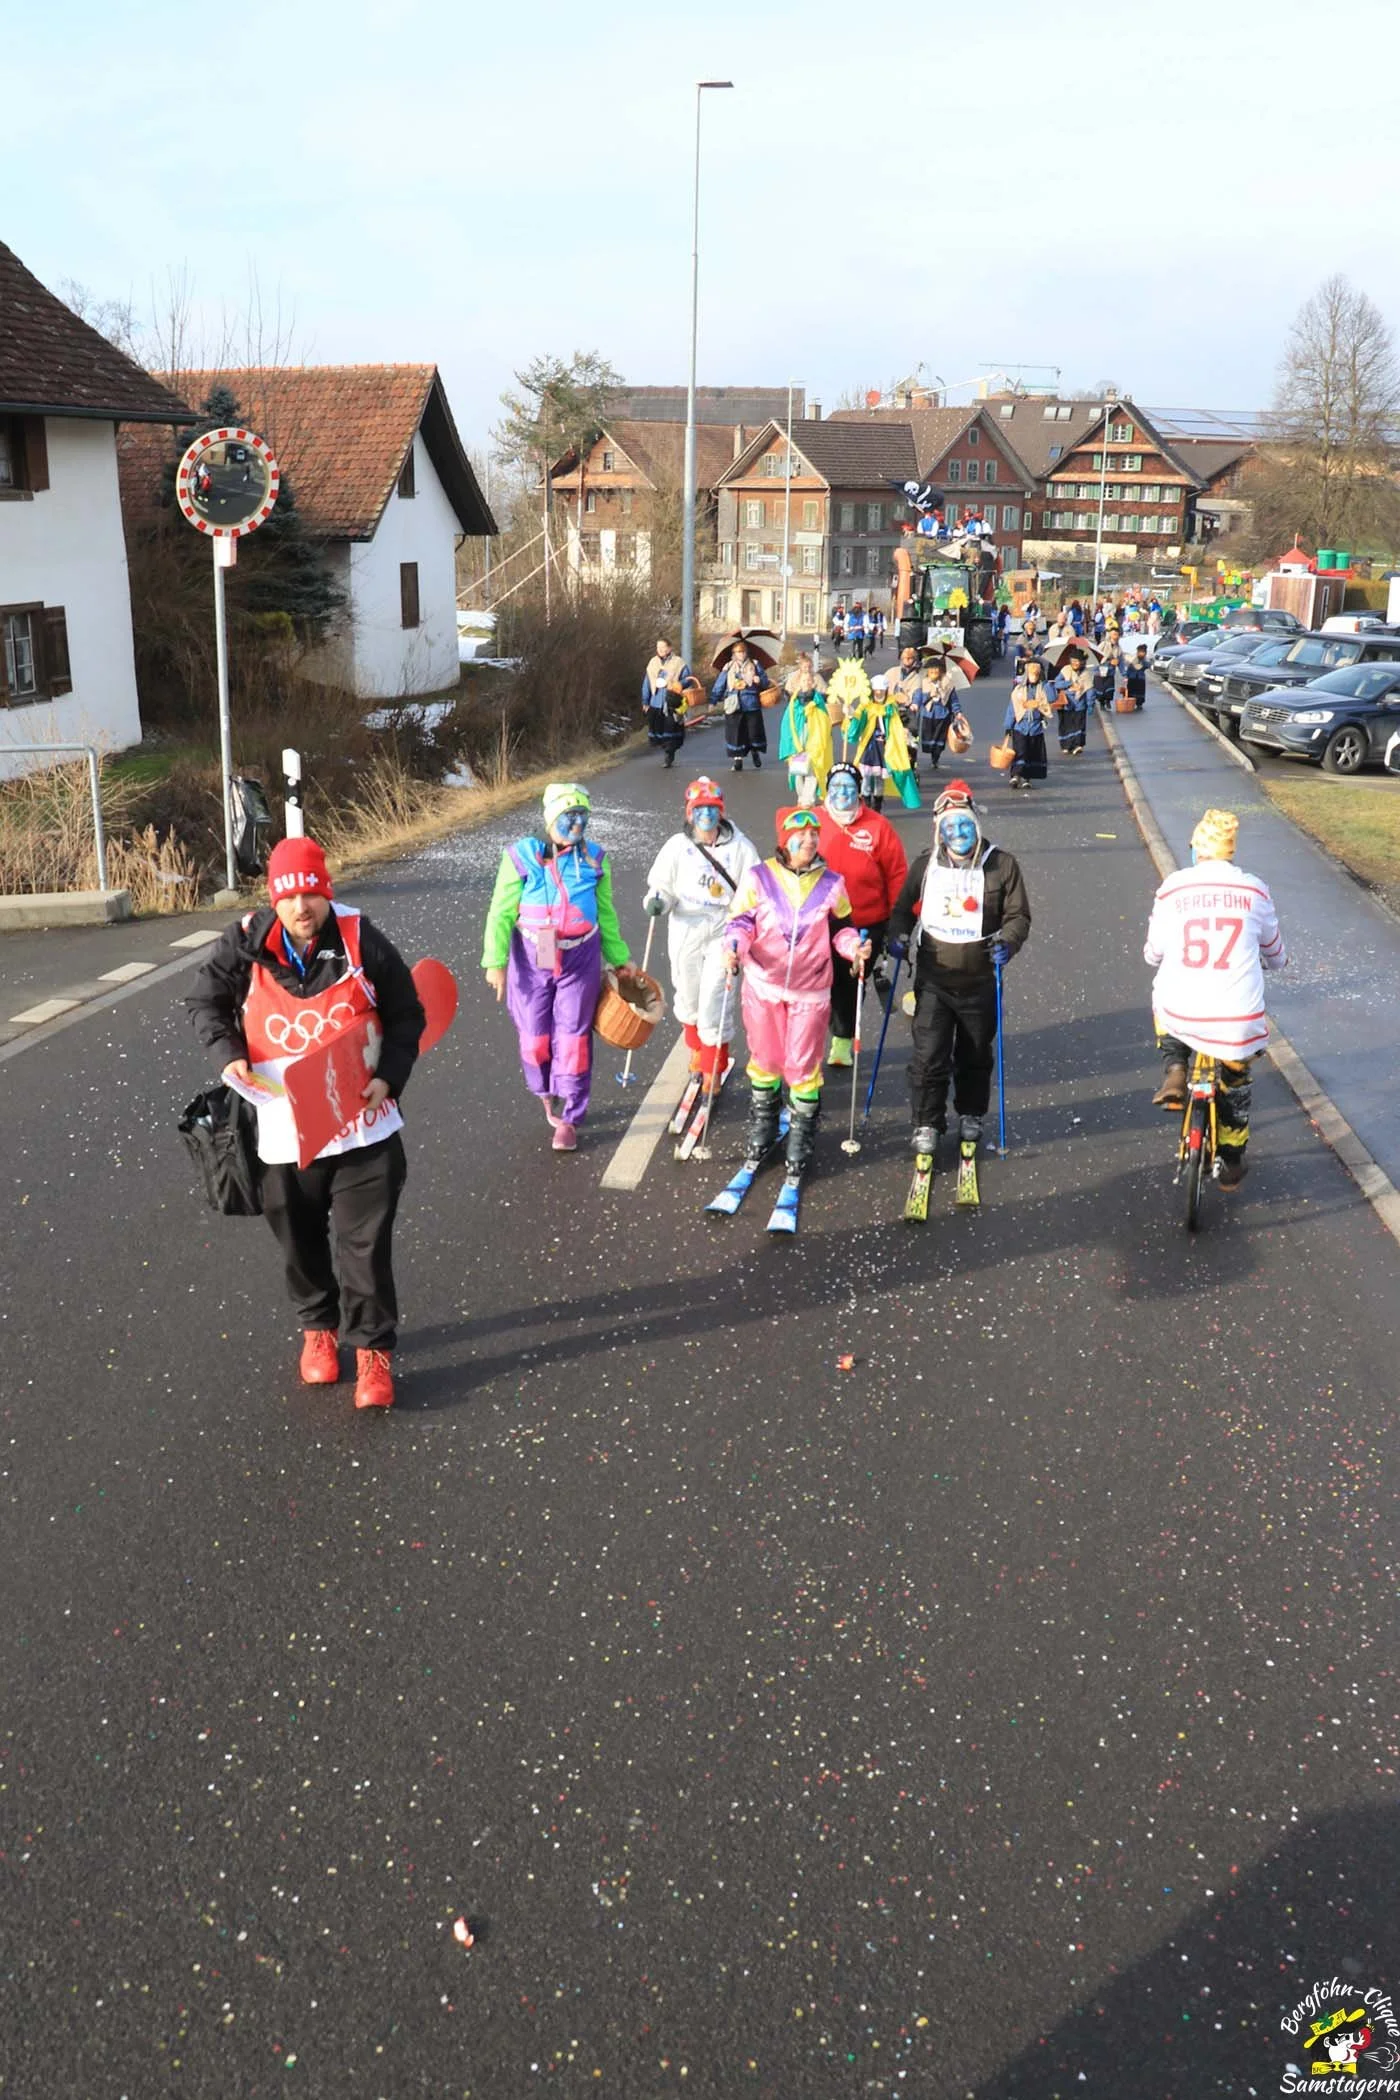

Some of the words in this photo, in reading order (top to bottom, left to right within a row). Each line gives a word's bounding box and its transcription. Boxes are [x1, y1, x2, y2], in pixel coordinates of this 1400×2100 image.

[274, 872, 304, 893] SUI
[1175, 891, 1252, 913] BERGFÖHN
[1182, 917, 1244, 970] 67
